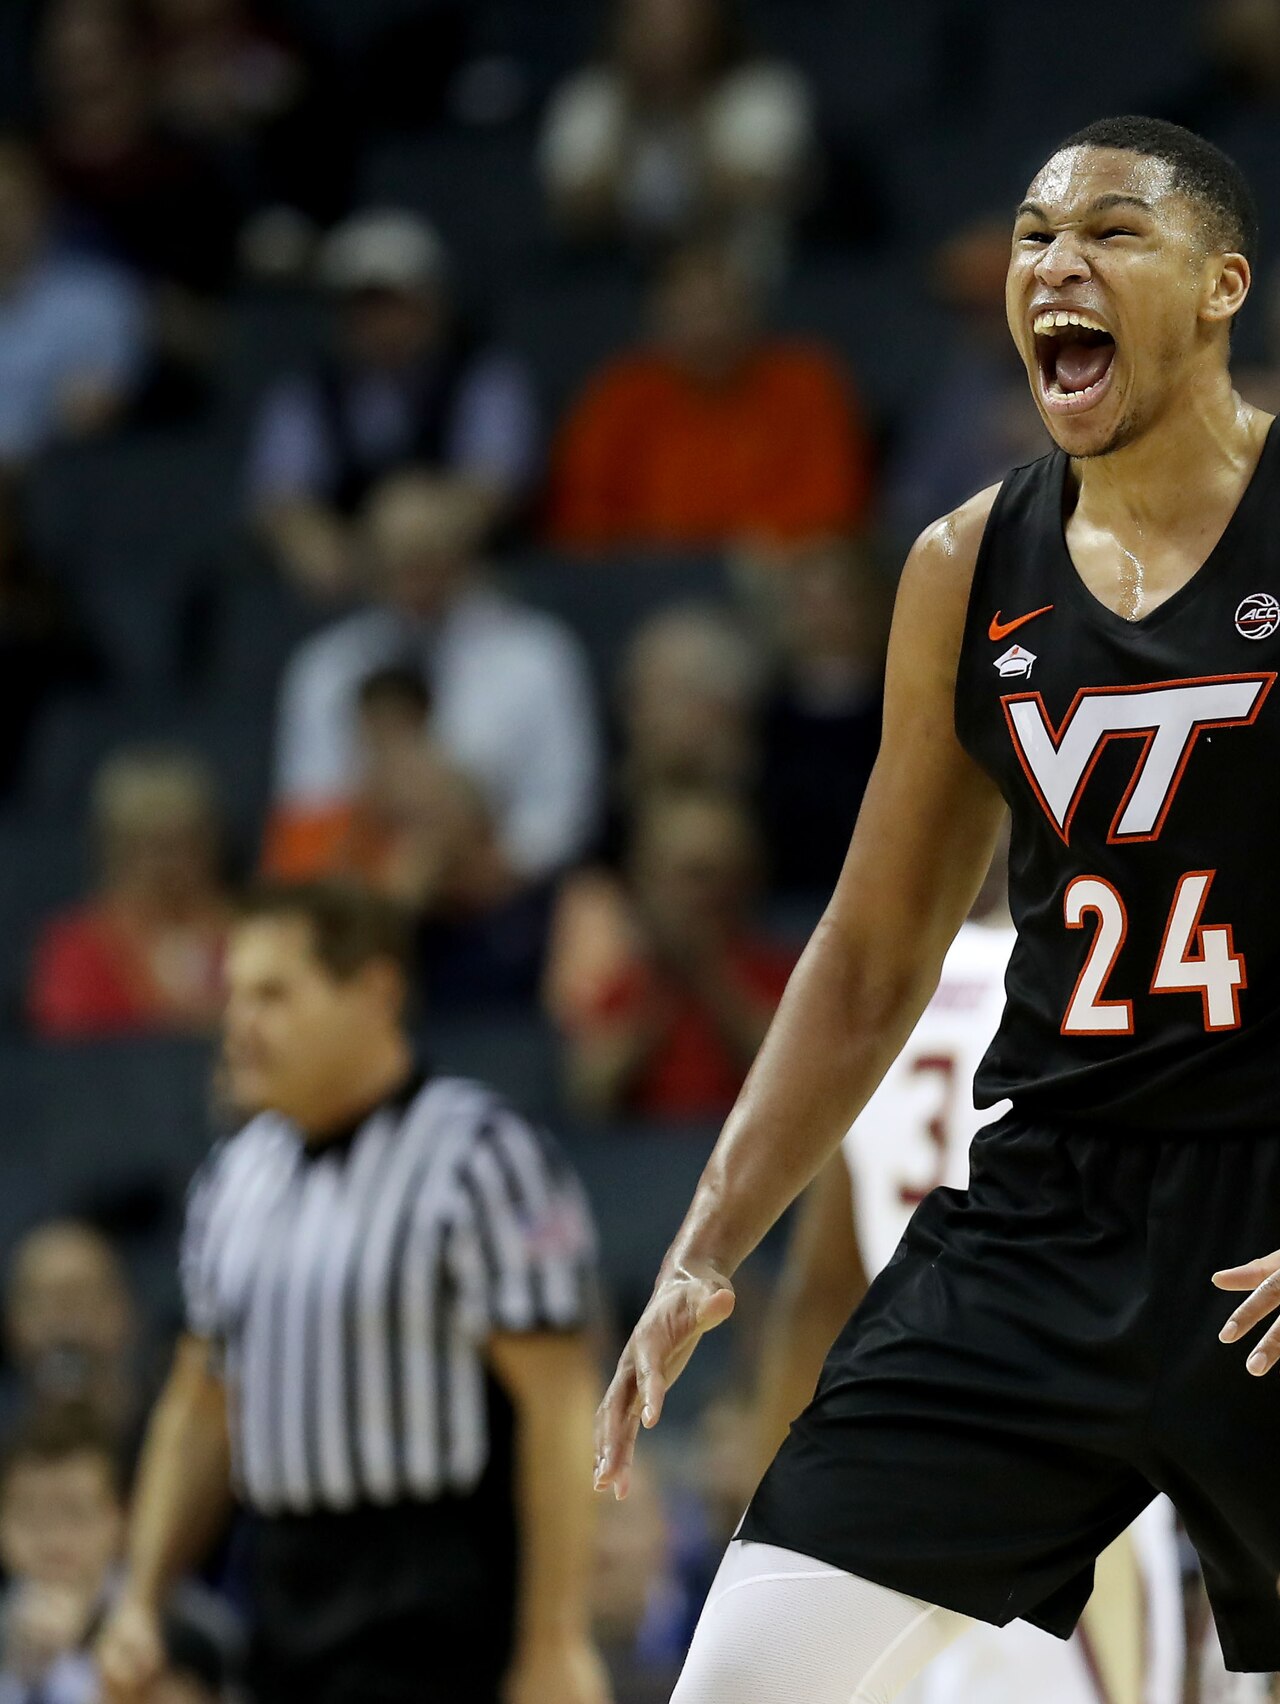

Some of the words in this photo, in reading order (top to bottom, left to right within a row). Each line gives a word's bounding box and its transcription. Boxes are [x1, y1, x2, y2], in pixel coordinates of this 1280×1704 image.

[1240, 608, 1279, 620] ACC
[1000, 672, 1278, 847] VT
[1060, 870, 1248, 1036] 24
